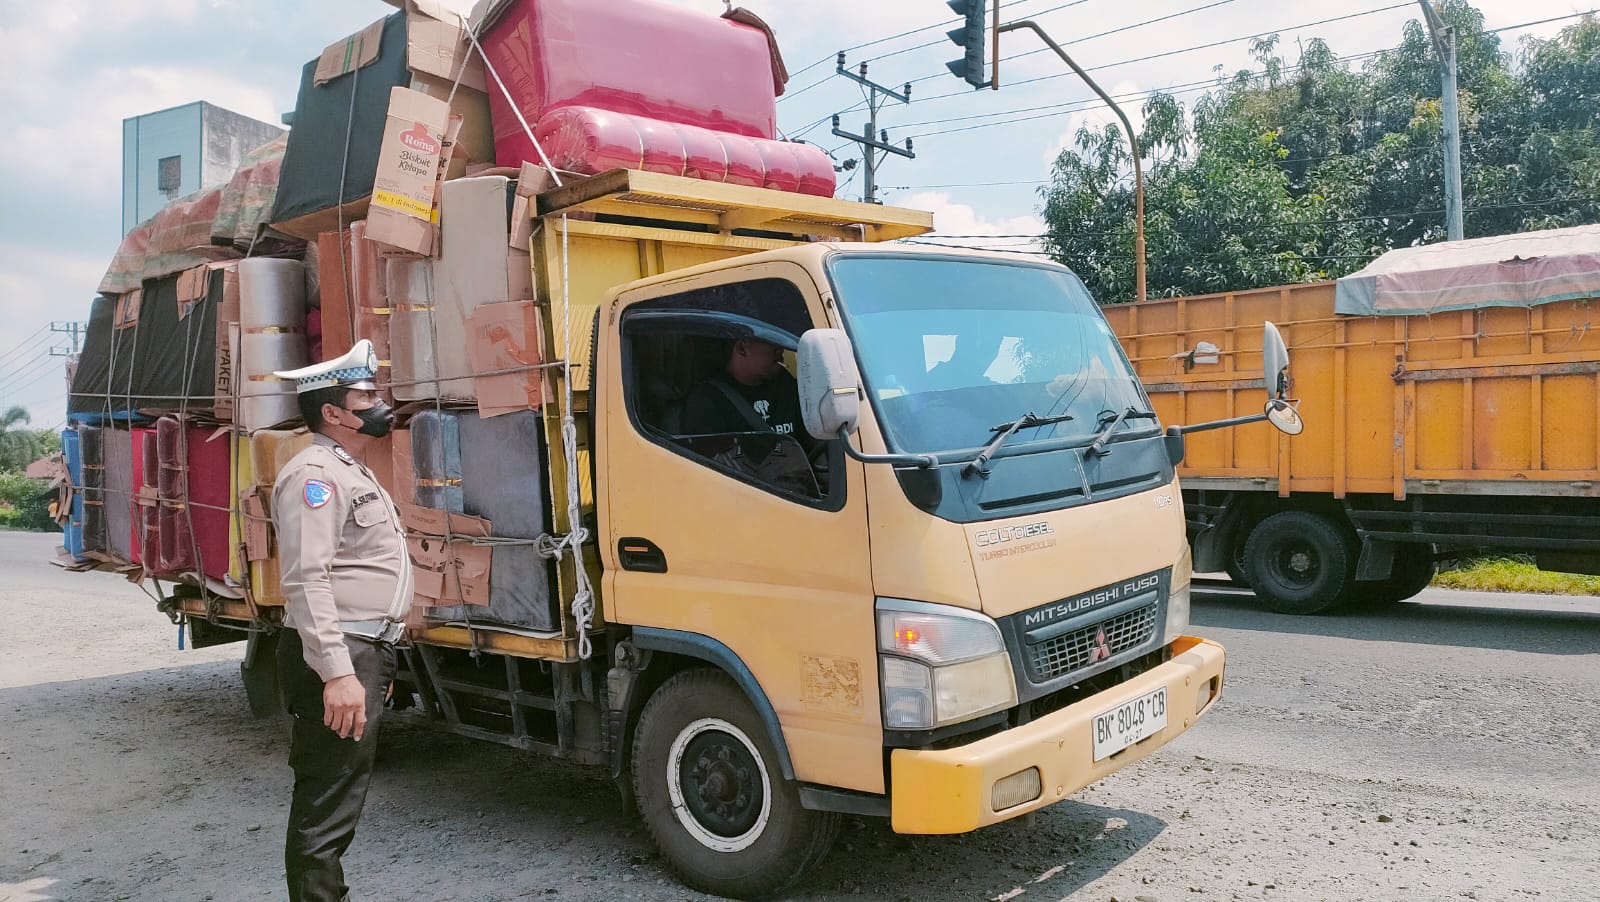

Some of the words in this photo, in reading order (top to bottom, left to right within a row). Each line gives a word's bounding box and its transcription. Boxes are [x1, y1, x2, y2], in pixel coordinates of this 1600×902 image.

[400, 150, 432, 168] Biskuit
[404, 134, 435, 152] Roma
[399, 160, 428, 176] Kelapa
[218, 348, 231, 394] PAKET
[1025, 588, 1119, 626] MITSUBISHI
[1123, 575, 1159, 594] FUSO
[1097, 714, 1112, 744] BK
[1118, 699, 1145, 733] 8048
[1152, 691, 1165, 718] CB
